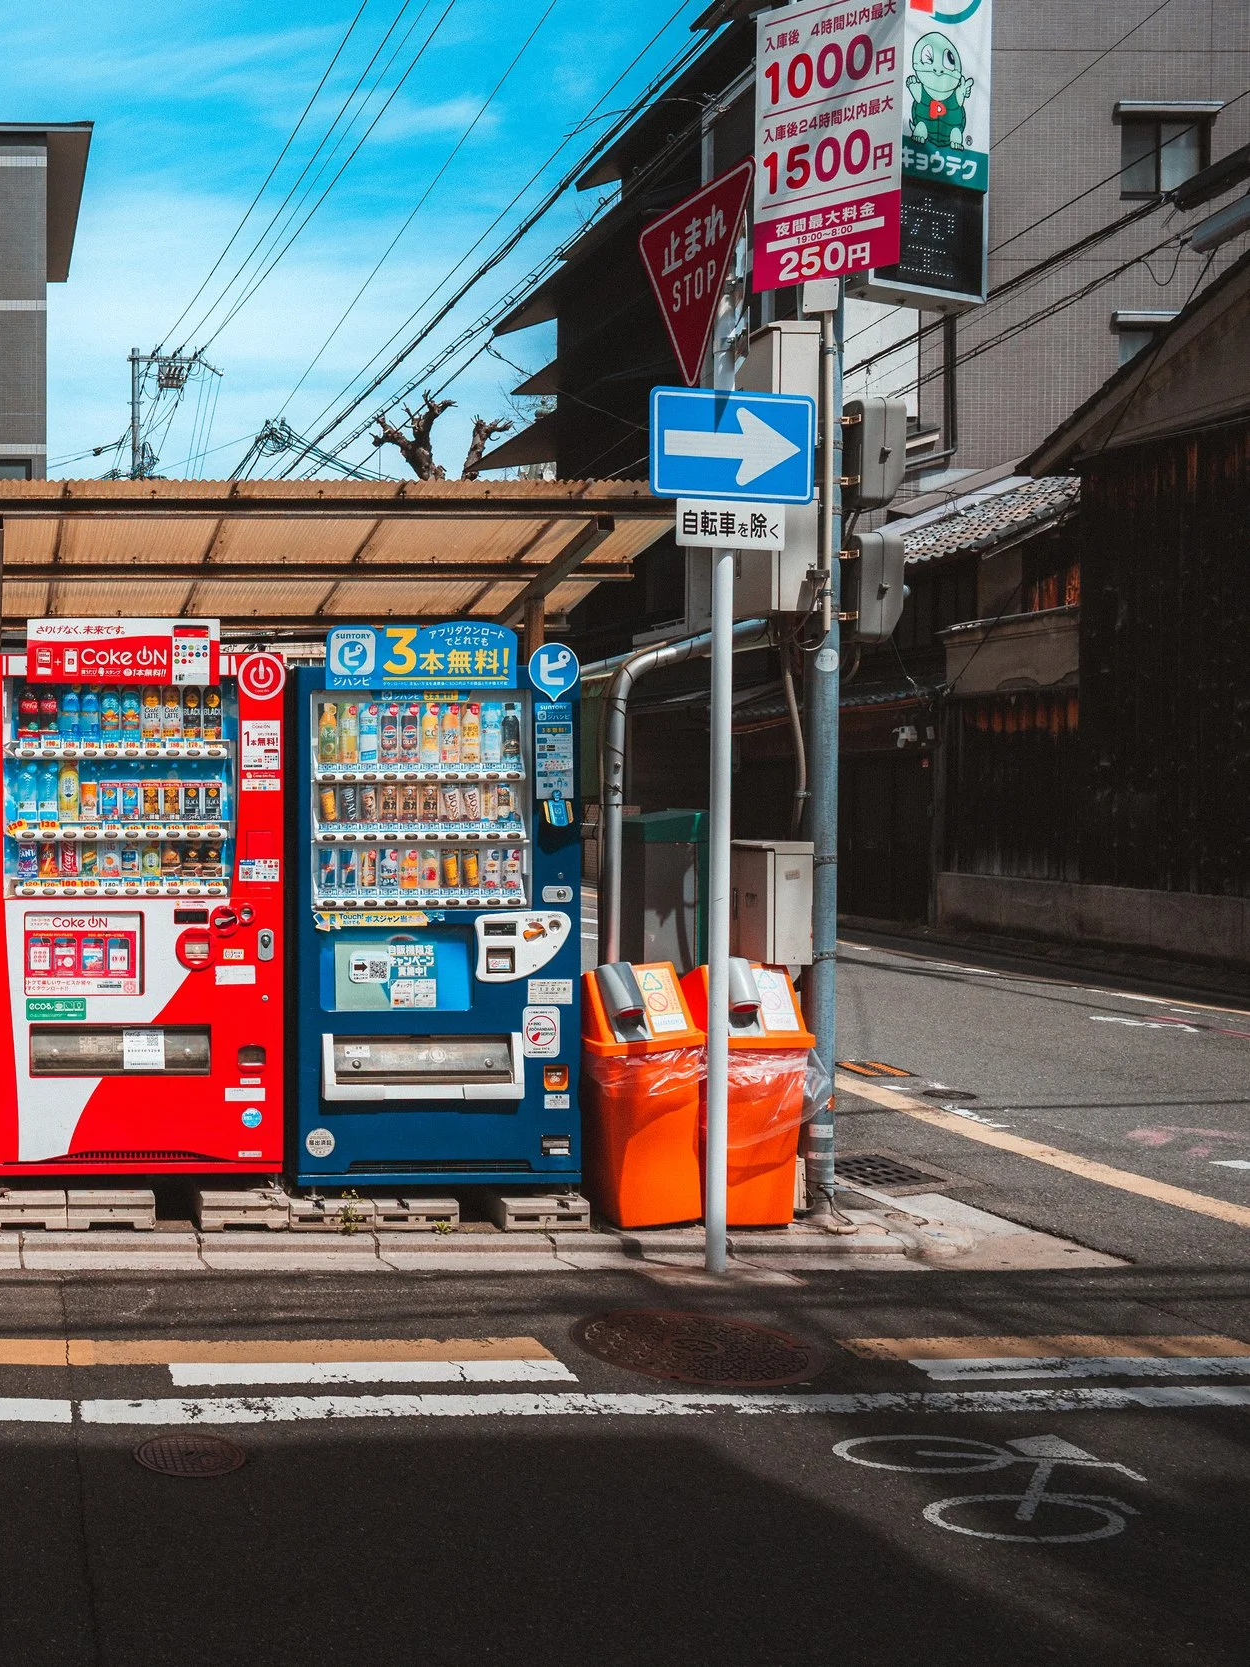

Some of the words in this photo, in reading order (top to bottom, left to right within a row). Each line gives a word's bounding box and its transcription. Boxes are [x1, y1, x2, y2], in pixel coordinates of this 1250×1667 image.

[764, 29, 800, 53] 入庫後
[810, 1, 897, 37] 4時間以内最大
[764, 33, 896, 106] 1000円
[763, 96, 894, 145] 入庫後24時間以内最大
[763, 129, 894, 196] 1500円
[775, 202, 876, 238] 夜間最大料金
[661, 204, 727, 277] 止まれ
[778, 241, 871, 282] 250円
[672, 258, 716, 313] STOP
[682, 509, 779, 540] 自転車を除く
[36, 625, 126, 636] さりげなく、未来です。
[428, 626, 506, 640] アプリダウンロード
[444, 637, 490, 647] でどれでも
[80, 647, 133, 666] Coke
[136, 645, 167, 666] ON
[382, 628, 510, 675] 3本無料!
[333, 677, 372, 686] ジハンピ
[448, 793, 459, 820] BOSS
[467, 792, 479, 820] BOSS
[52, 916, 86, 928] Coke
[339, 912, 364, 920] Touch!
